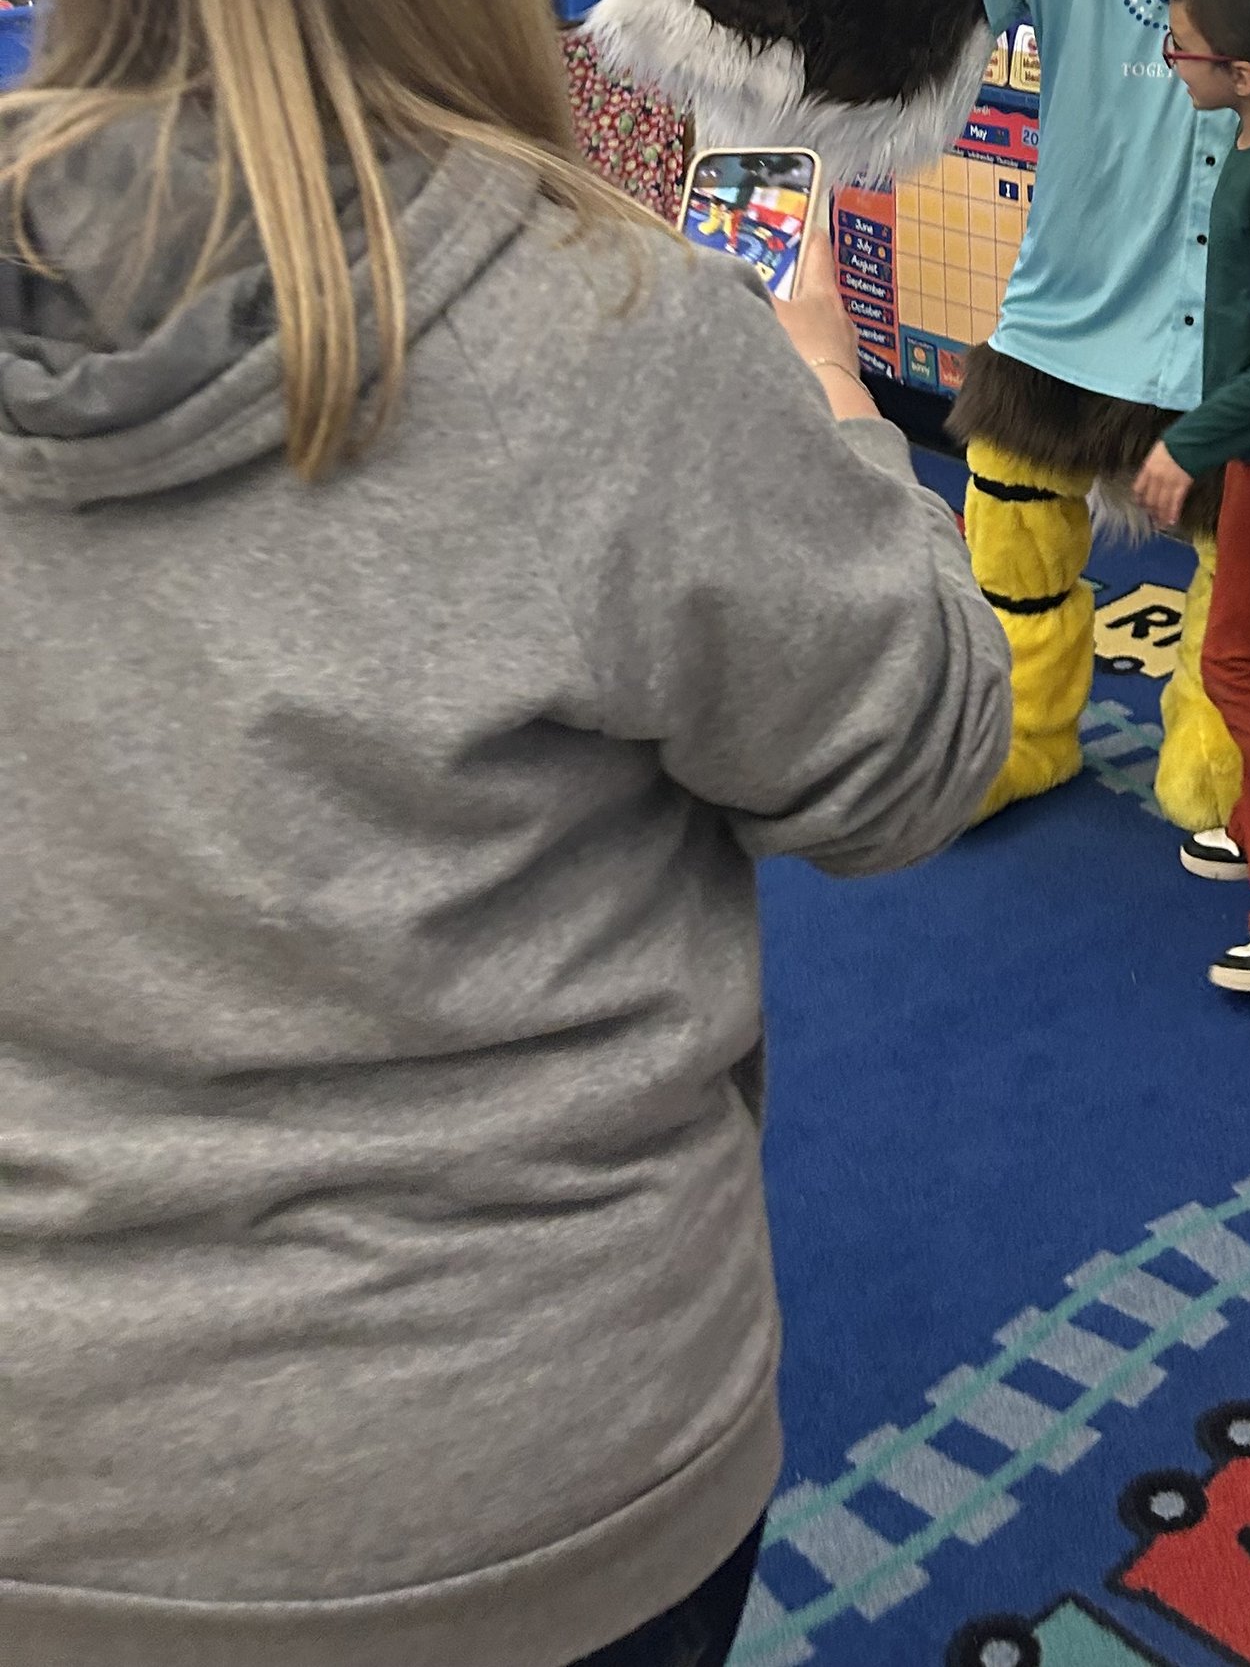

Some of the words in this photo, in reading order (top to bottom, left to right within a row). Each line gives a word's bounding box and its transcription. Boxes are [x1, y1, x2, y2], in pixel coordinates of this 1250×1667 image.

[1121, 62, 1173, 79] TOGET
[970, 124, 987, 141] May
[1023, 129, 1039, 146] 20
[1005, 184, 1012, 198] 1
[855, 218, 873, 235] June
[856, 238, 872, 255] July
[851, 254, 878, 276] August
[845, 274, 887, 297] September
[850, 299, 883, 318] October
